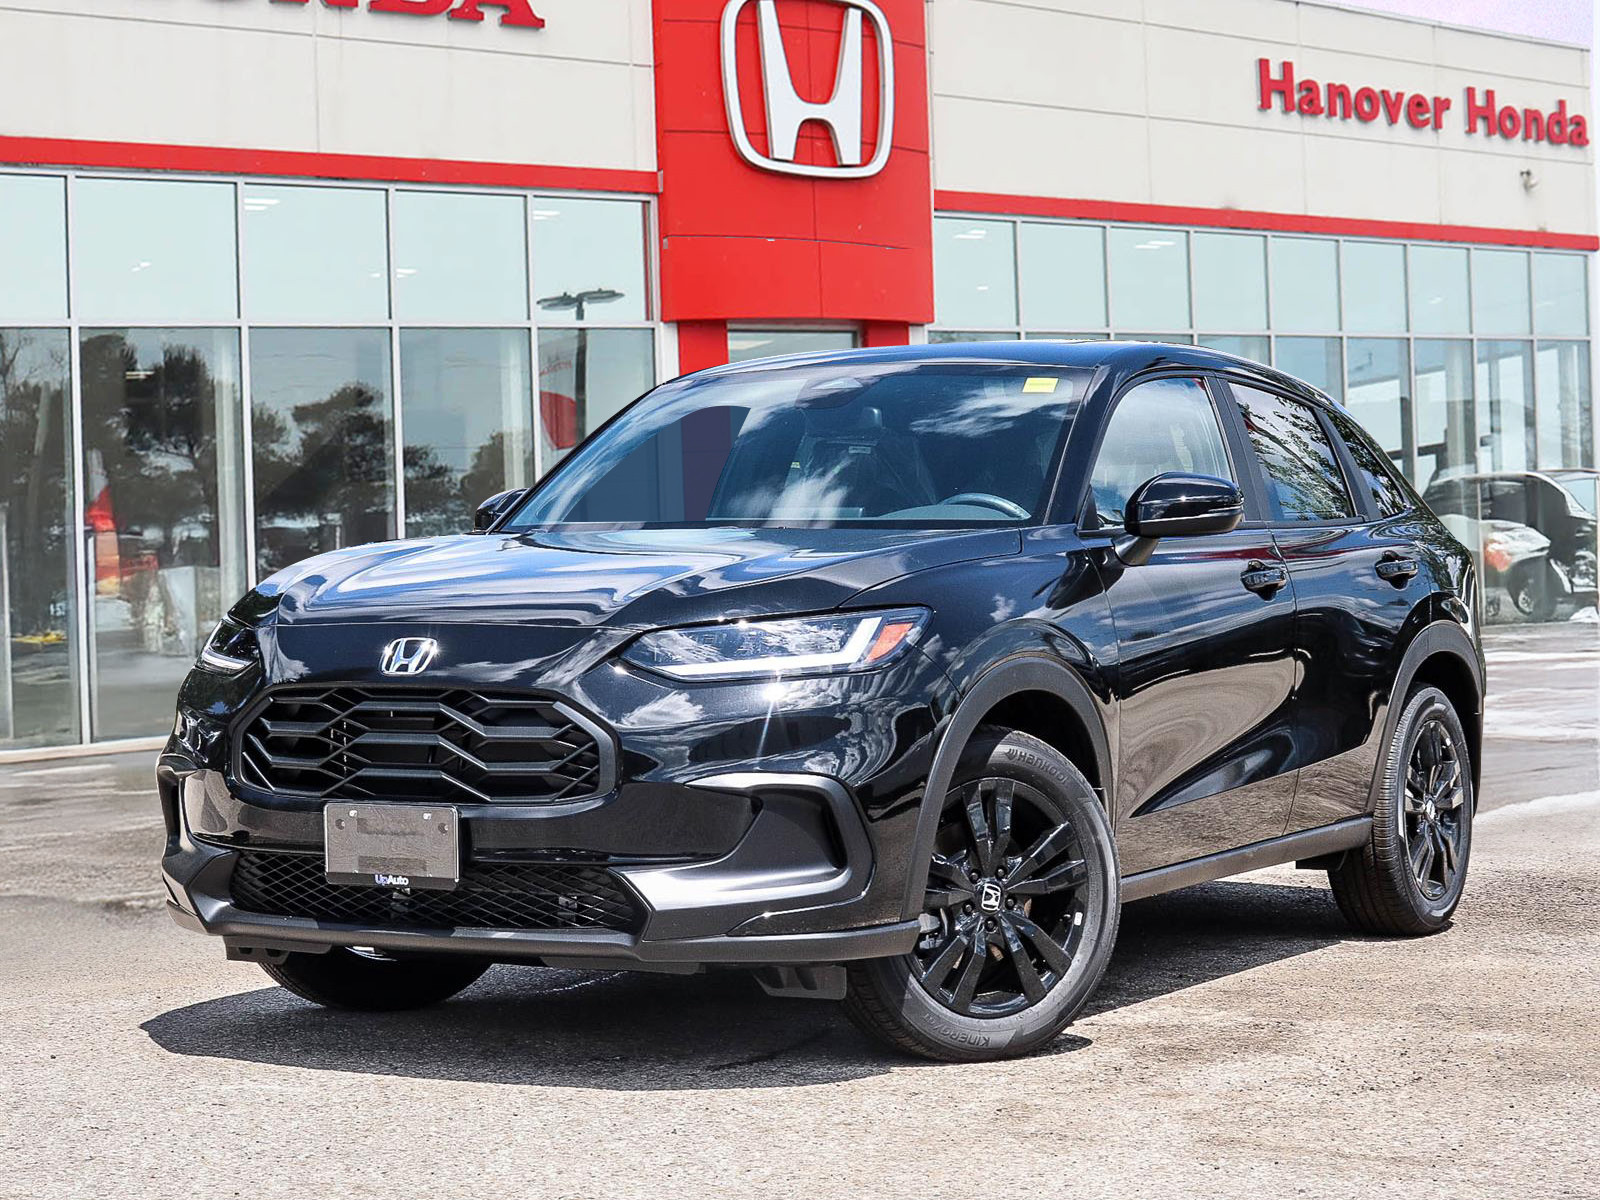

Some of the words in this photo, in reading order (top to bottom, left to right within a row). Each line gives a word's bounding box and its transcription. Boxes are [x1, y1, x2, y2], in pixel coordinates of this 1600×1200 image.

[1258, 57, 1452, 130] Hanover
[1466, 86, 1589, 147] Honda
[374, 873, 410, 886] UpAuto
